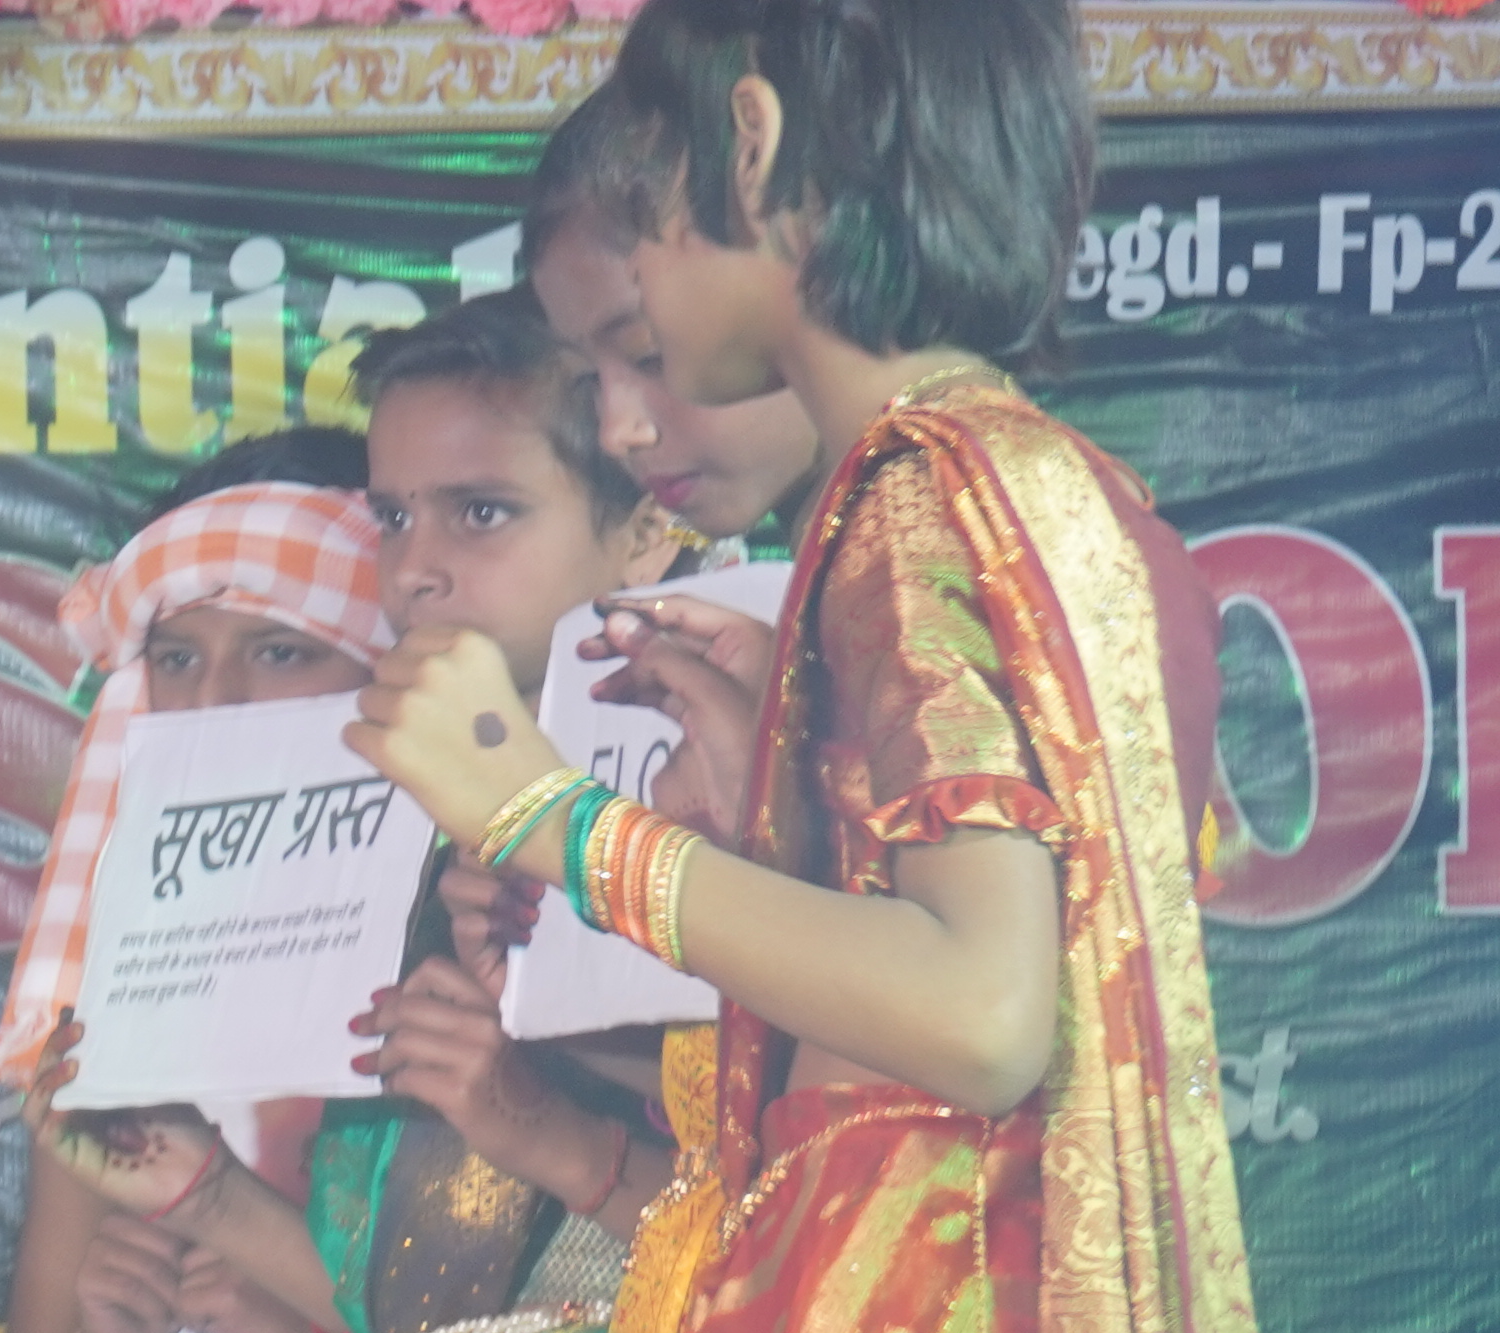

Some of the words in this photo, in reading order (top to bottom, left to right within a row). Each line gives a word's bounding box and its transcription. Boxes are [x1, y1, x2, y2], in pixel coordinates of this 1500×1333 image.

[1066, 196, 1283, 321] egd.-
[153, 792, 287, 901] सूखा
[282, 775, 398, 862] ग्रस्त
